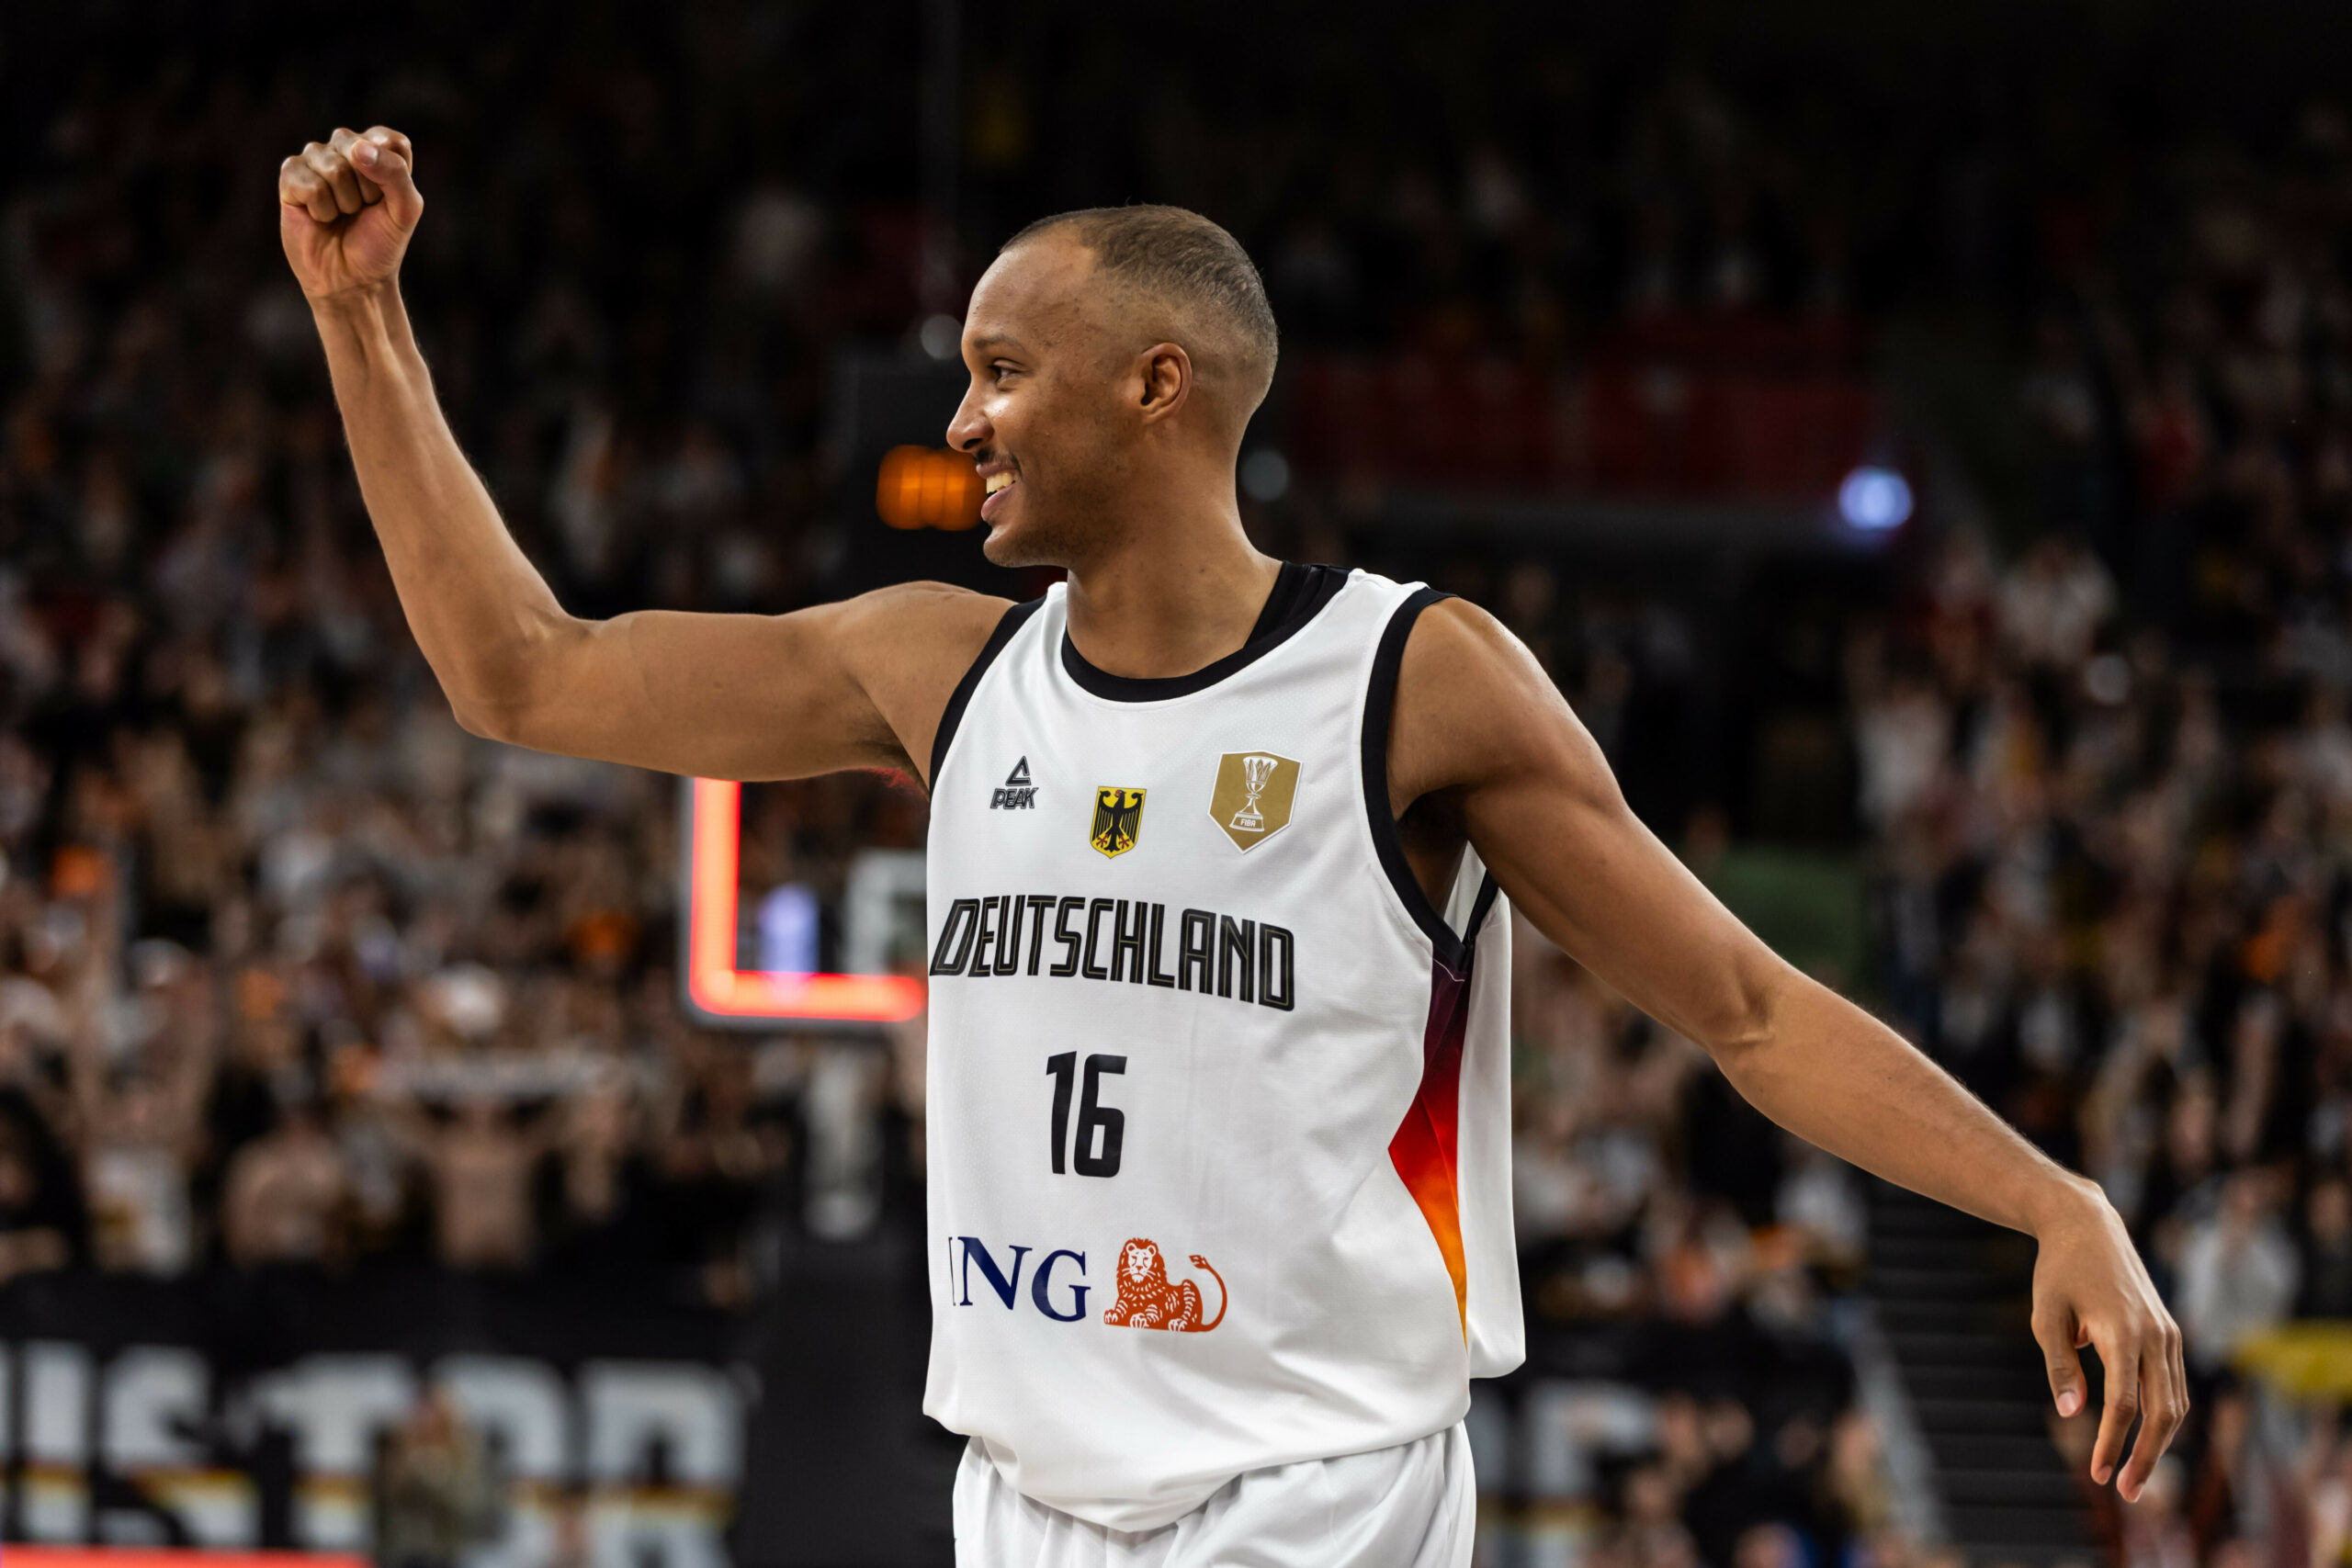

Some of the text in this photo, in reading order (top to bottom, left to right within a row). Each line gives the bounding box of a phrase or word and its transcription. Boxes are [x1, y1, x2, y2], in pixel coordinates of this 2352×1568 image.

[989, 787, 1039, 809] PEAK
[1239, 818, 1256, 828] FIBA
[929, 894, 1295, 1012] DEUTSCHLAND
[1046, 1050, 1128, 1179] 16
[948, 1235, 1091, 1323] NG
